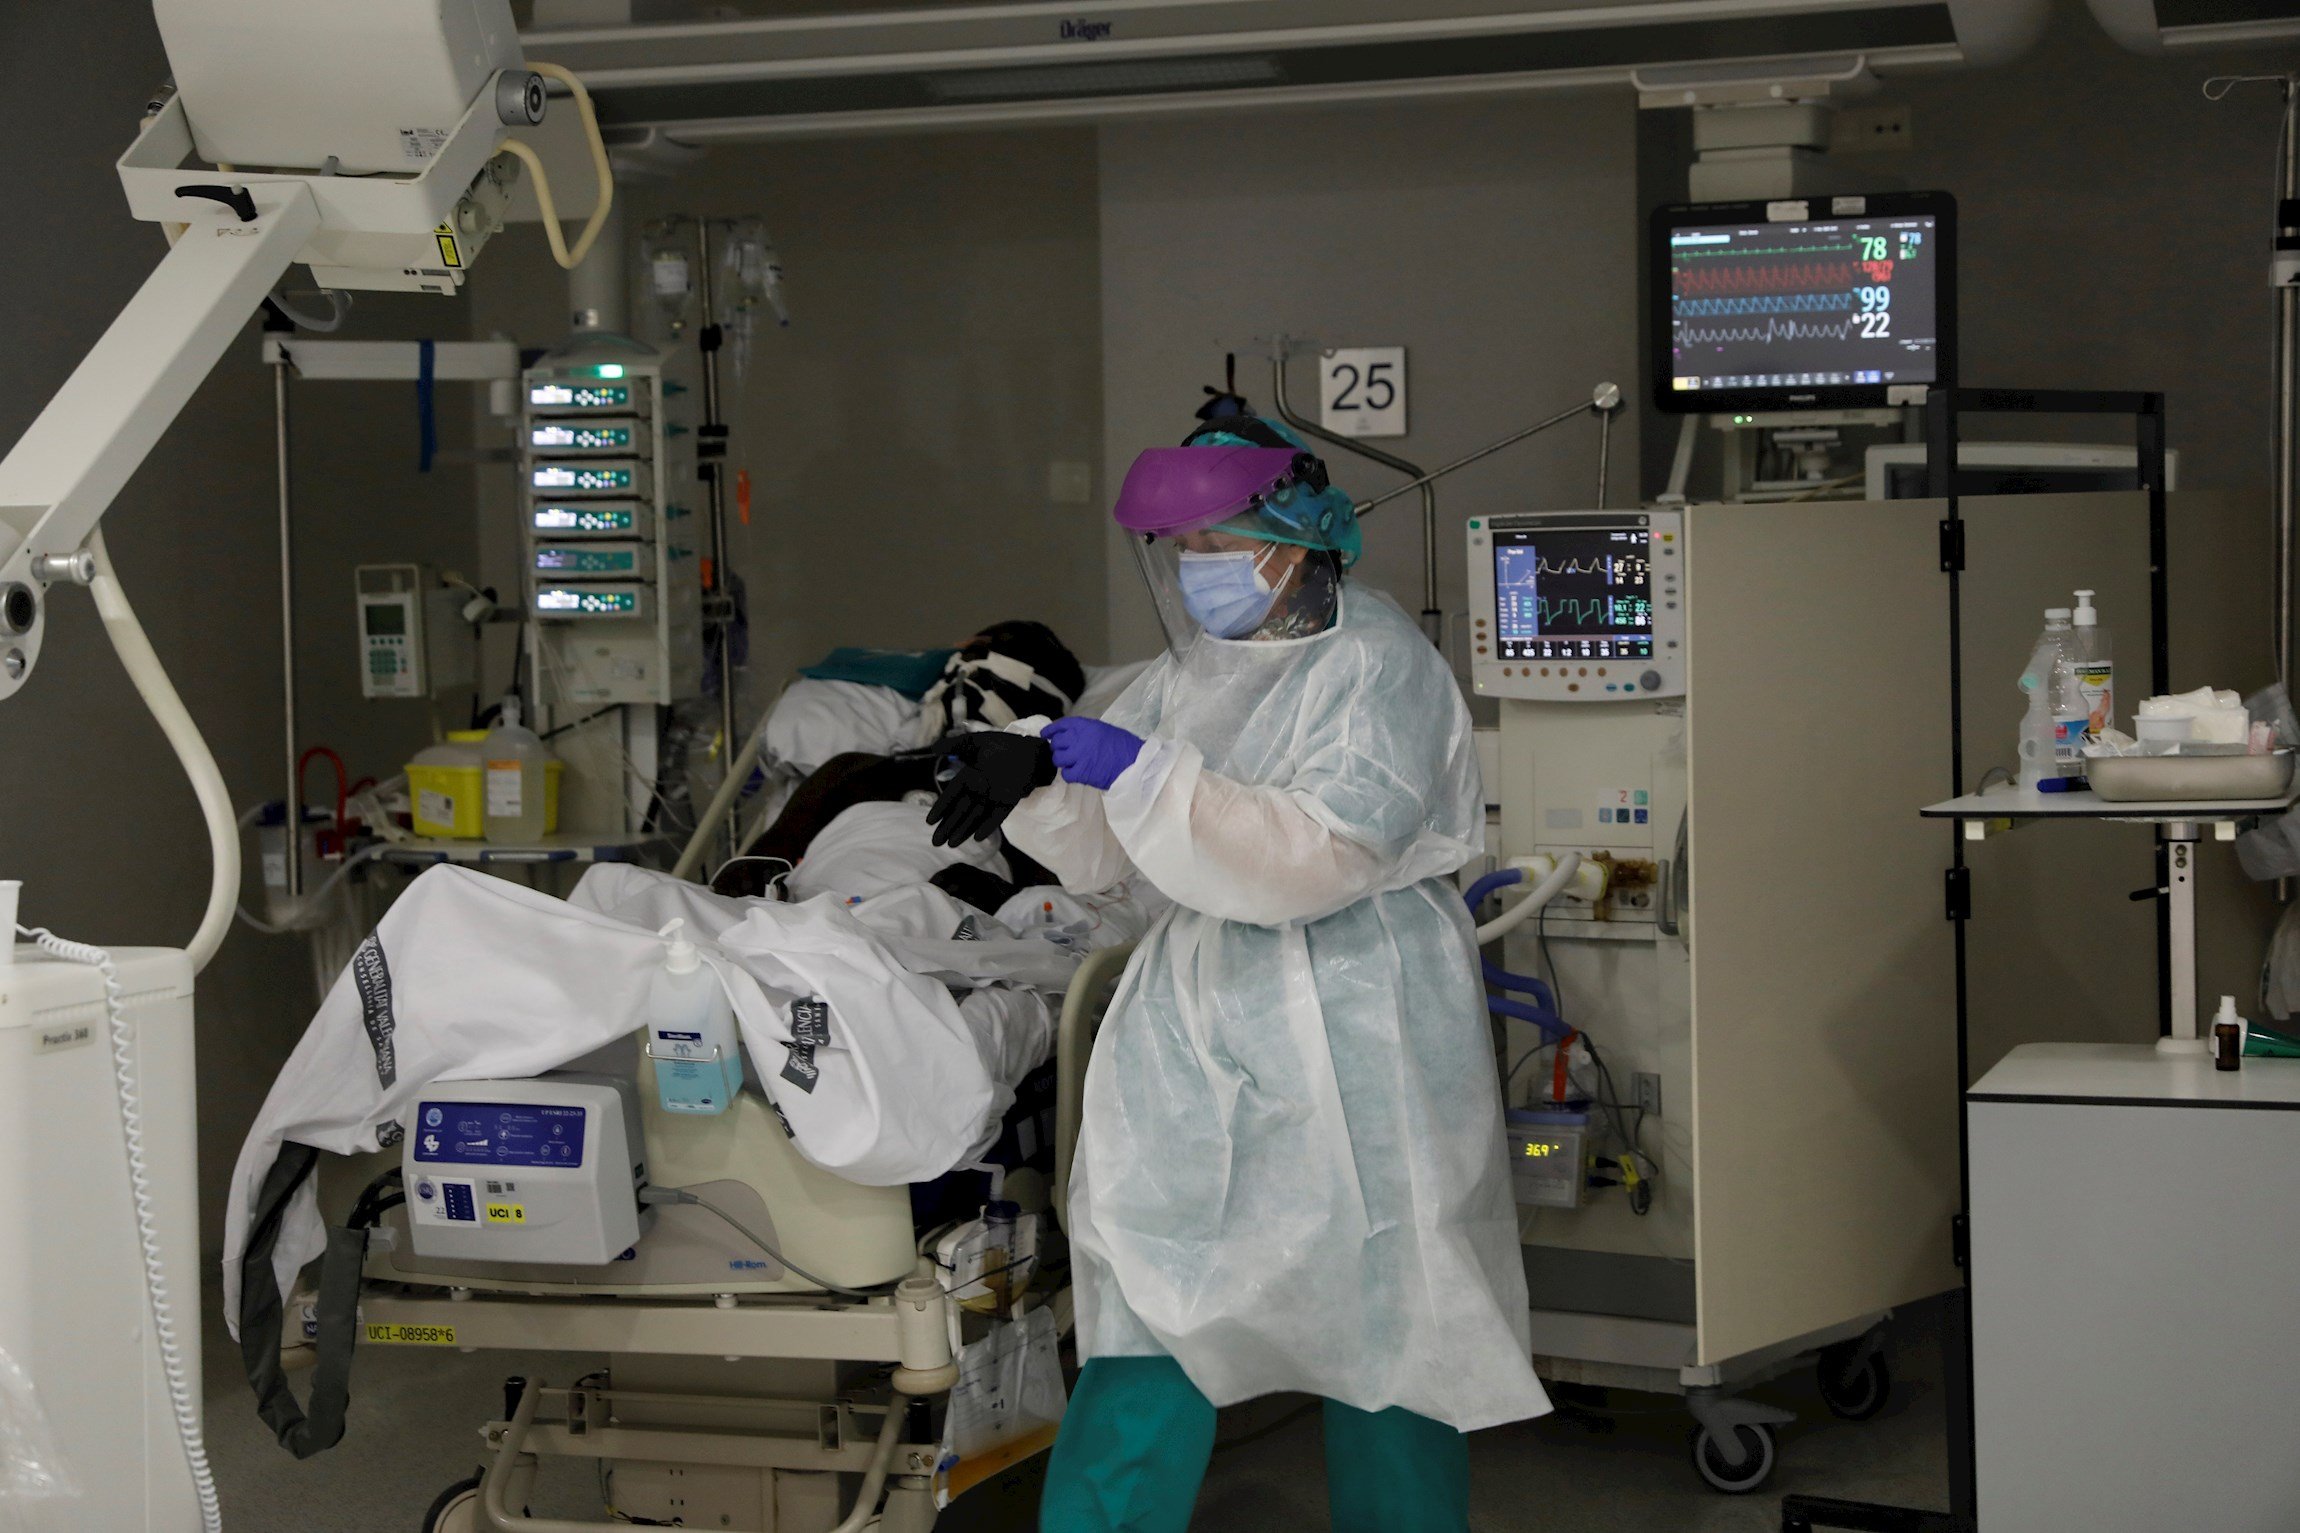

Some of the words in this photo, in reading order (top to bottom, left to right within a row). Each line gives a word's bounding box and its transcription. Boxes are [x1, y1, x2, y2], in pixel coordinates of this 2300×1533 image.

[1060, 18, 1112, 41] Dräger
[1861, 236, 1887, 261] 78
[1860, 286, 1891, 312] 99
[1860, 312, 1891, 339] 22
[1331, 362, 1396, 410] 25
[1619, 789, 1628, 803] 2
[363, 948, 389, 1008] GENERALITAT
[489, 1208, 509, 1219] UCI
[515, 1208, 523, 1219] 8
